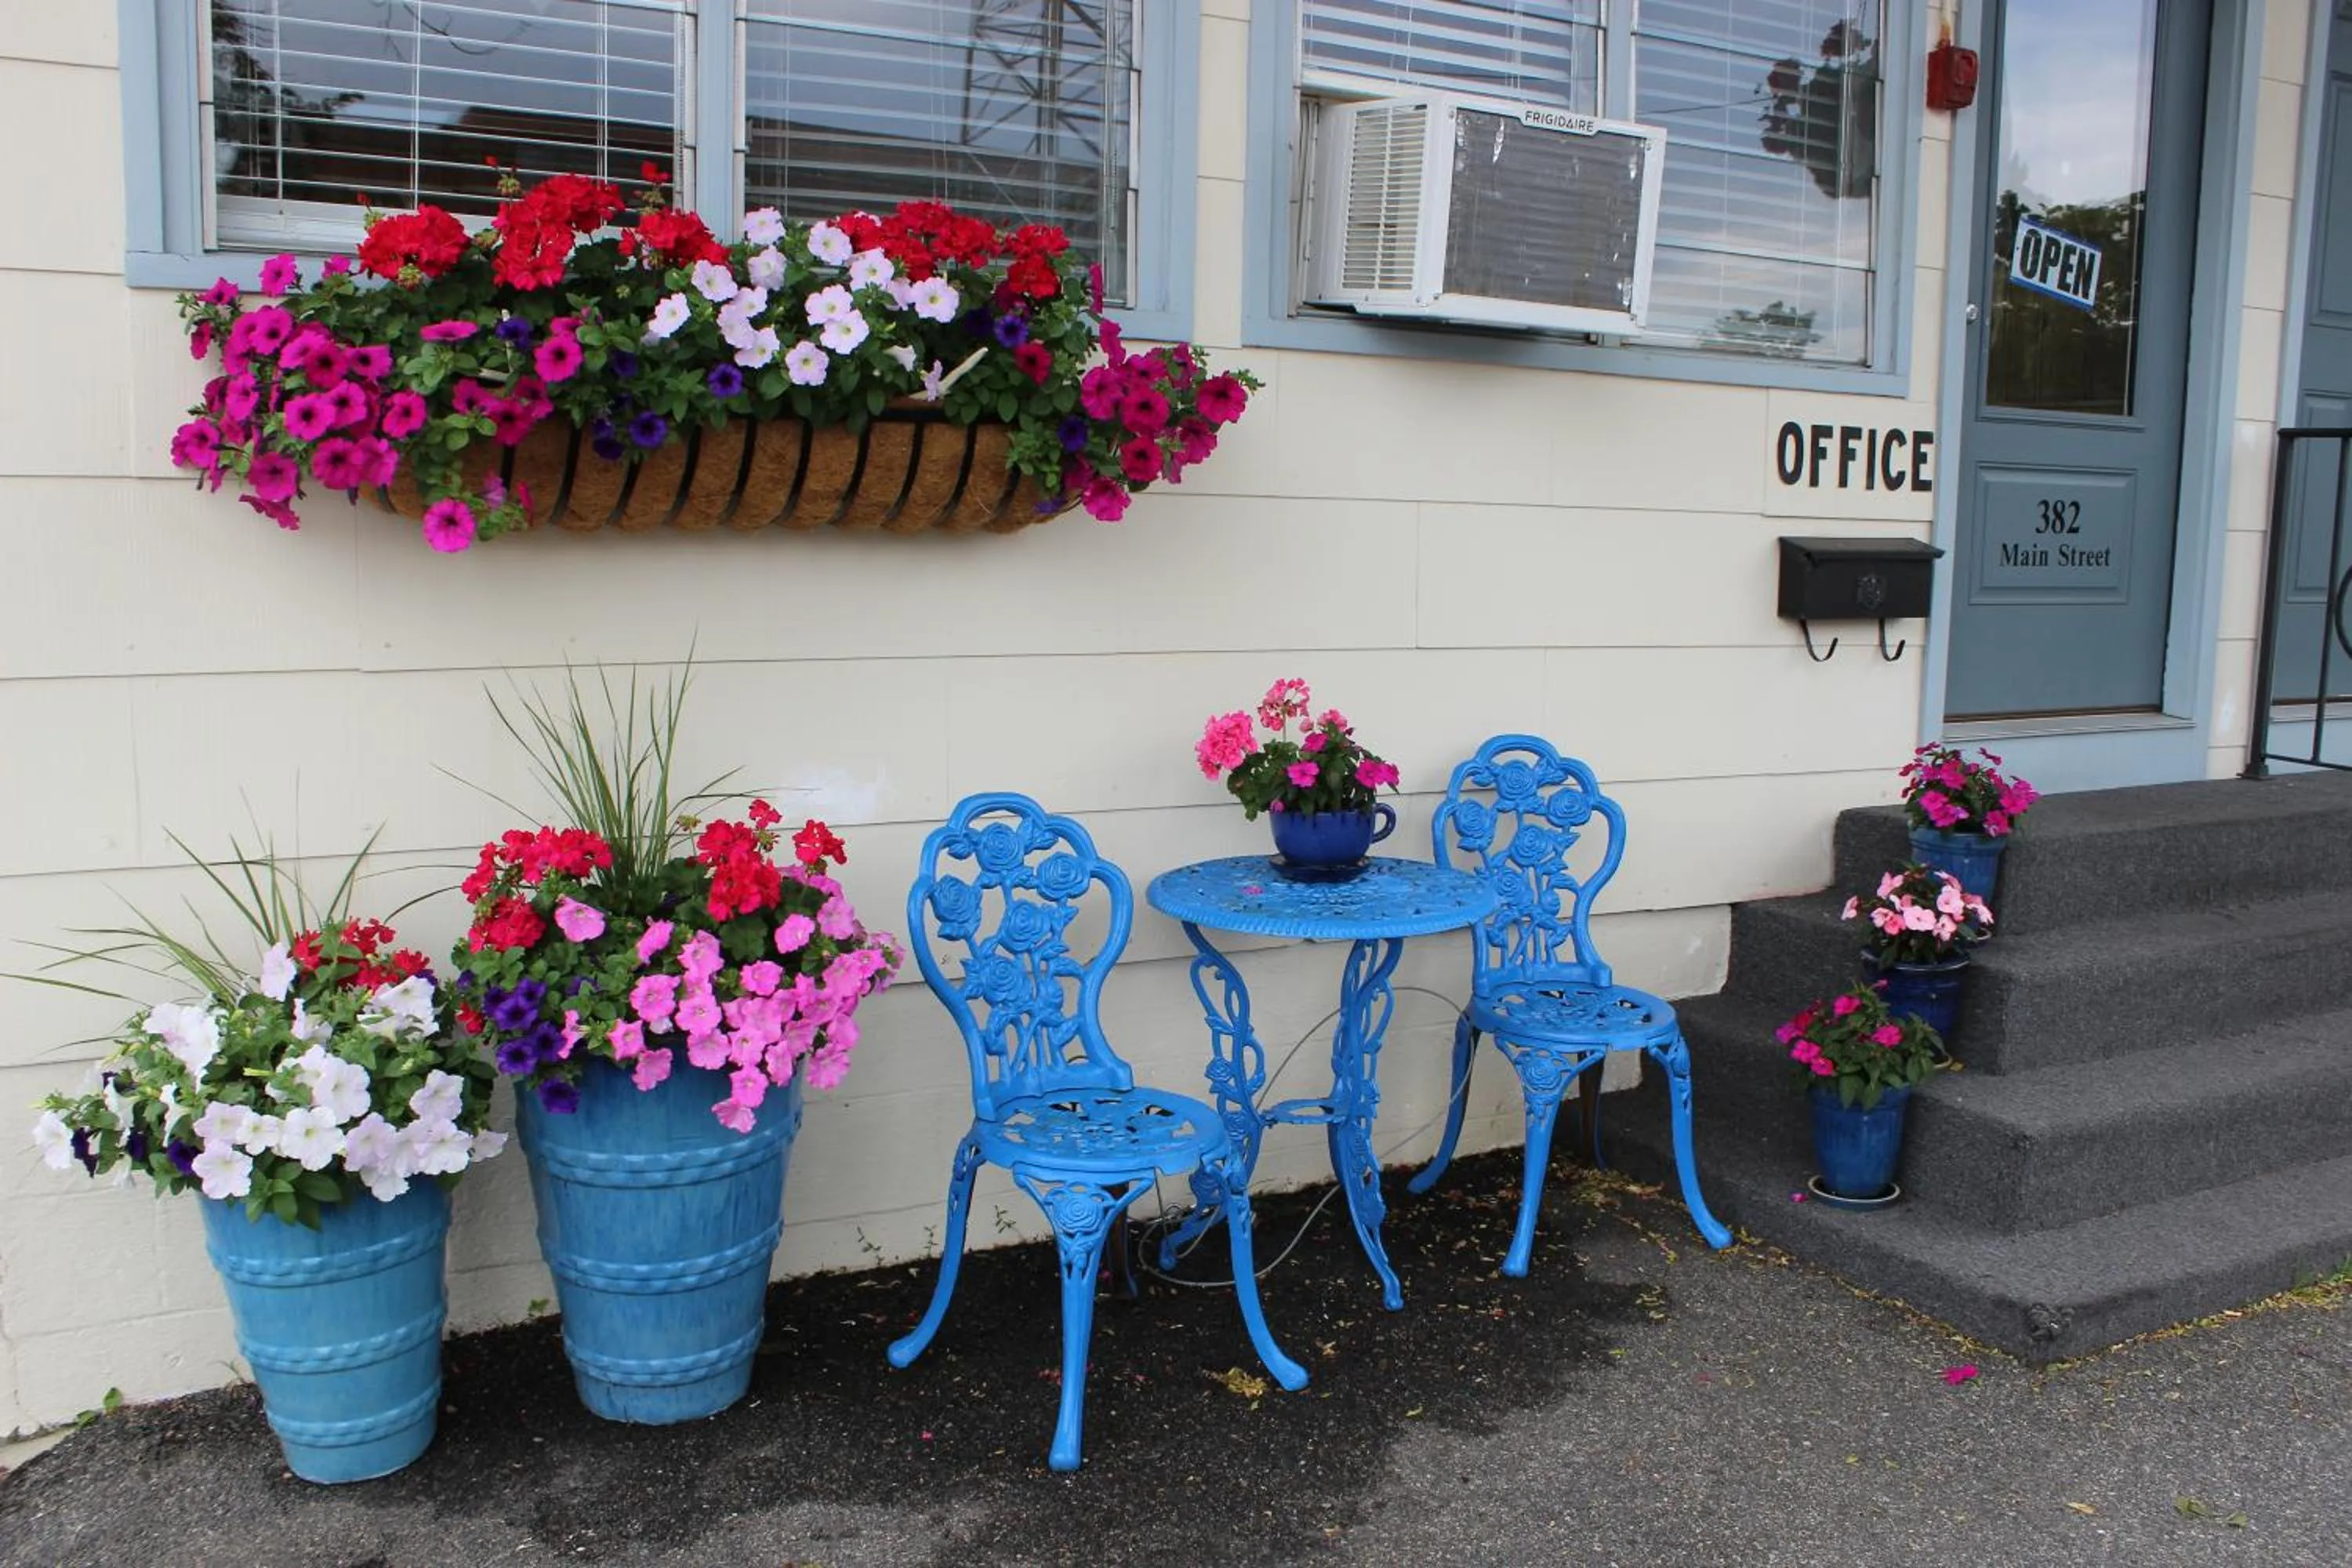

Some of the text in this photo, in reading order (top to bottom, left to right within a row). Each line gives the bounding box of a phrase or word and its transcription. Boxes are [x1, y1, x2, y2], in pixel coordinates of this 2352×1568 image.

[1525, 111, 1595, 132] FRIGIDAIRE
[2020, 228, 2096, 300] OPEN
[1777, 421, 1934, 492] OFFICE
[2035, 499, 2081, 534] 382
[2000, 543, 2111, 567] Main Street
